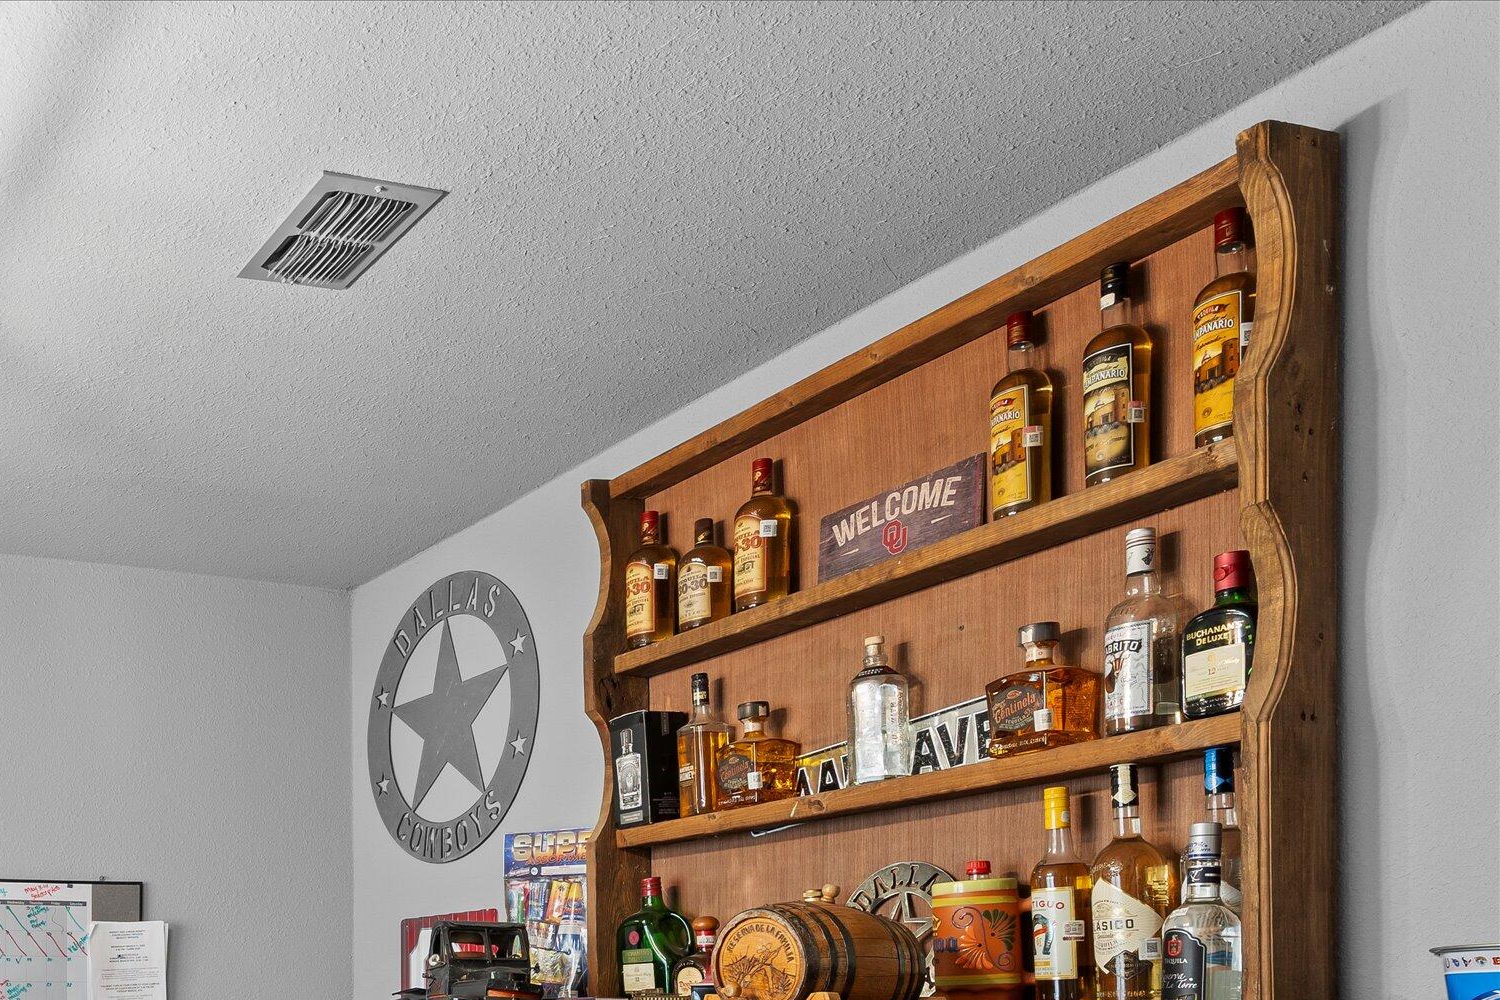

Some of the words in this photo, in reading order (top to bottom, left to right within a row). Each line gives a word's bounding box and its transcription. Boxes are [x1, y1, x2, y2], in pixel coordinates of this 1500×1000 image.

[832, 476, 962, 547] WELCOME
[394, 577, 501, 657] DALLAS
[396, 790, 501, 863] COWBOYS
